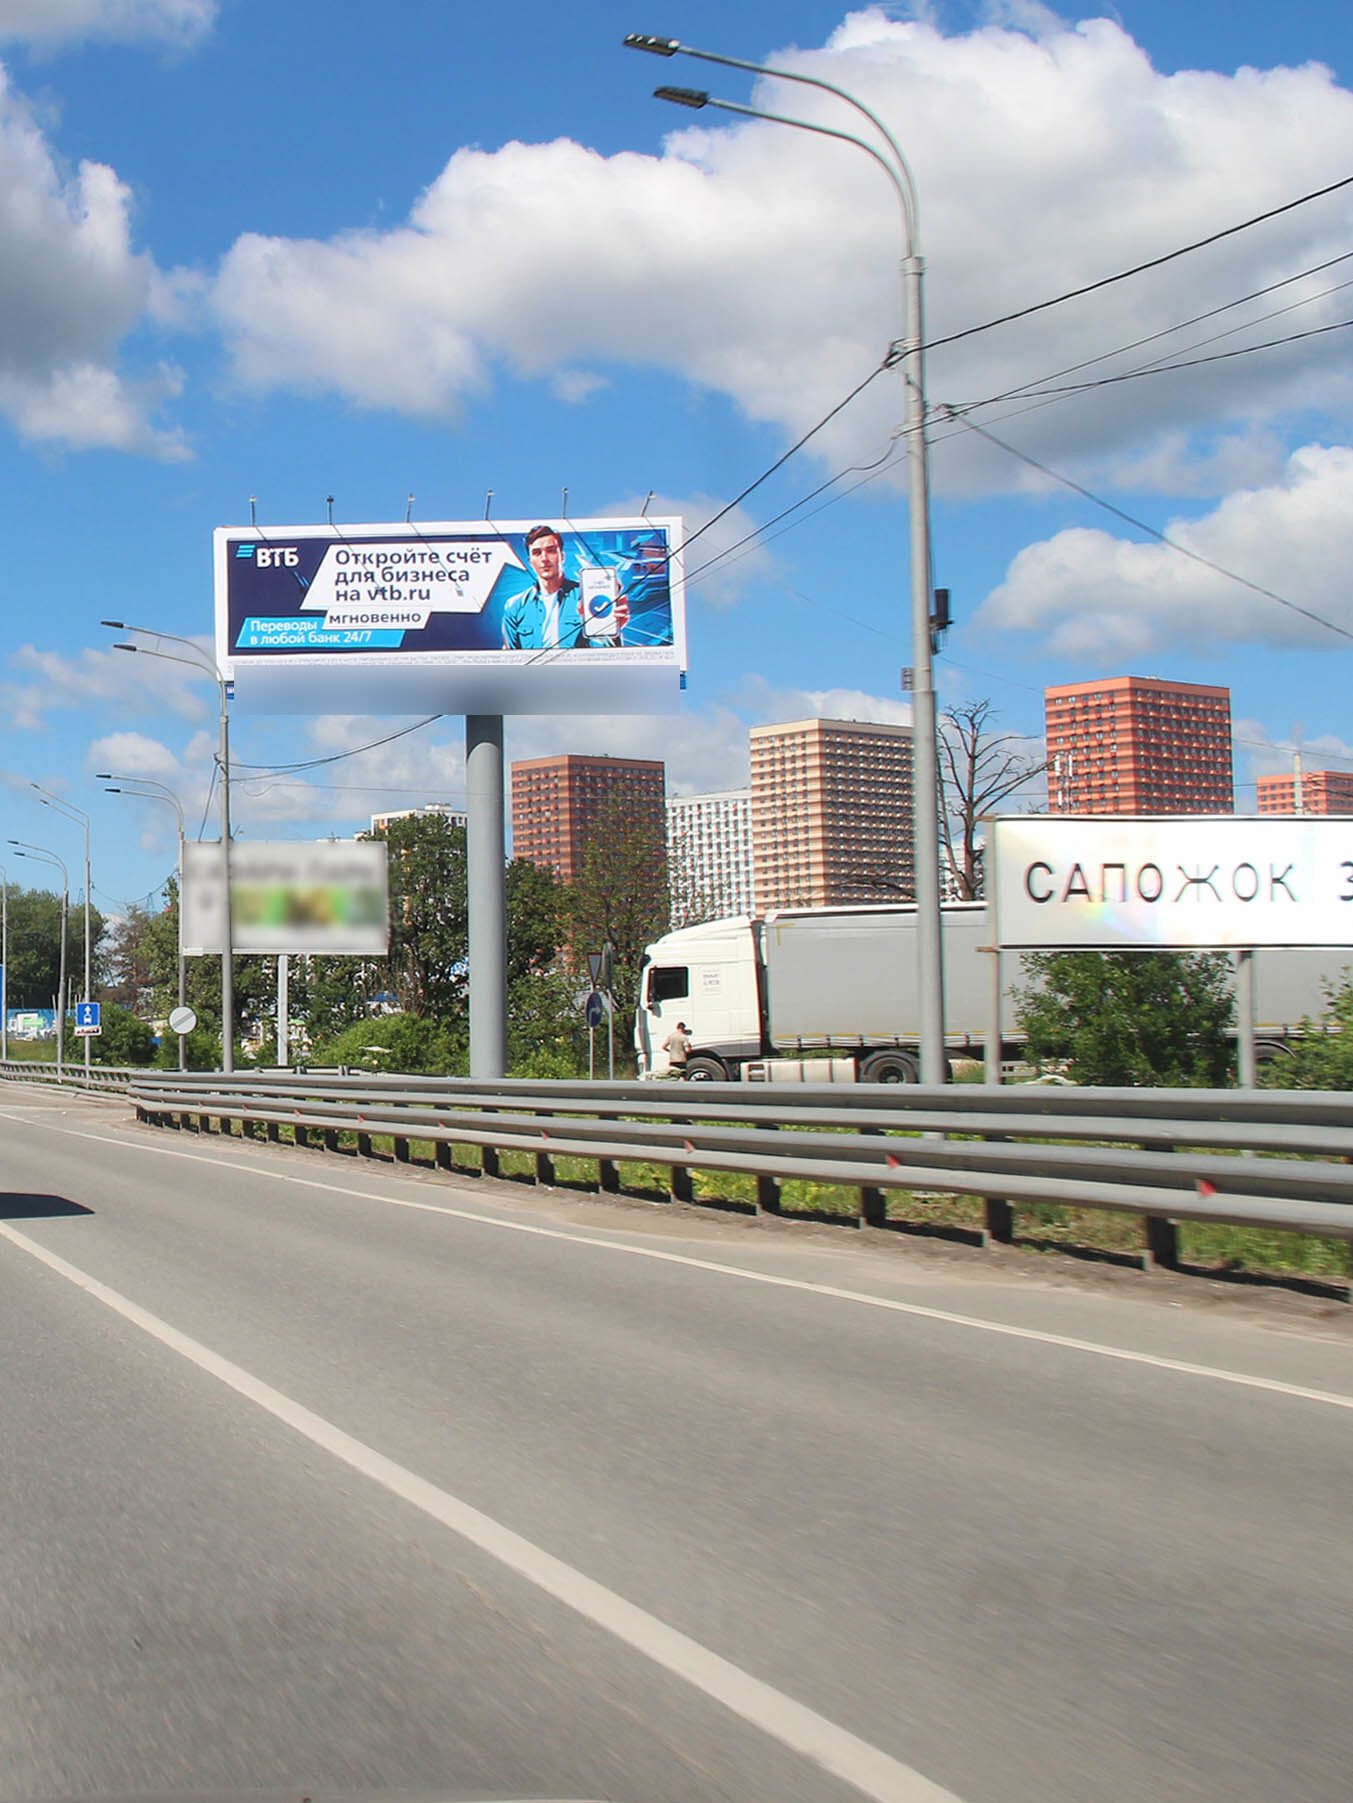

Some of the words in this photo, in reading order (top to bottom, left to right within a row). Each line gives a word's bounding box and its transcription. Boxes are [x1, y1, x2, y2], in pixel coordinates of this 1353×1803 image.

[257, 547, 299, 568] ВТБ
[335, 548, 440, 568] Откройте
[446, 547, 492, 564] счёт
[335, 570, 375, 586] для
[381, 566, 470, 583] бизнеса
[336, 588, 361, 601] на
[368, 585, 431, 602] vtb.ru
[250, 620, 318, 634] Переводы
[328, 613, 422, 625] мгновенно
[250, 637, 258, 645] в
[261, 632, 307, 645] любой
[308, 630, 341, 644] банк
[343, 630, 372, 643] 24/7
[1025, 861, 1298, 903] САПОЖОК
